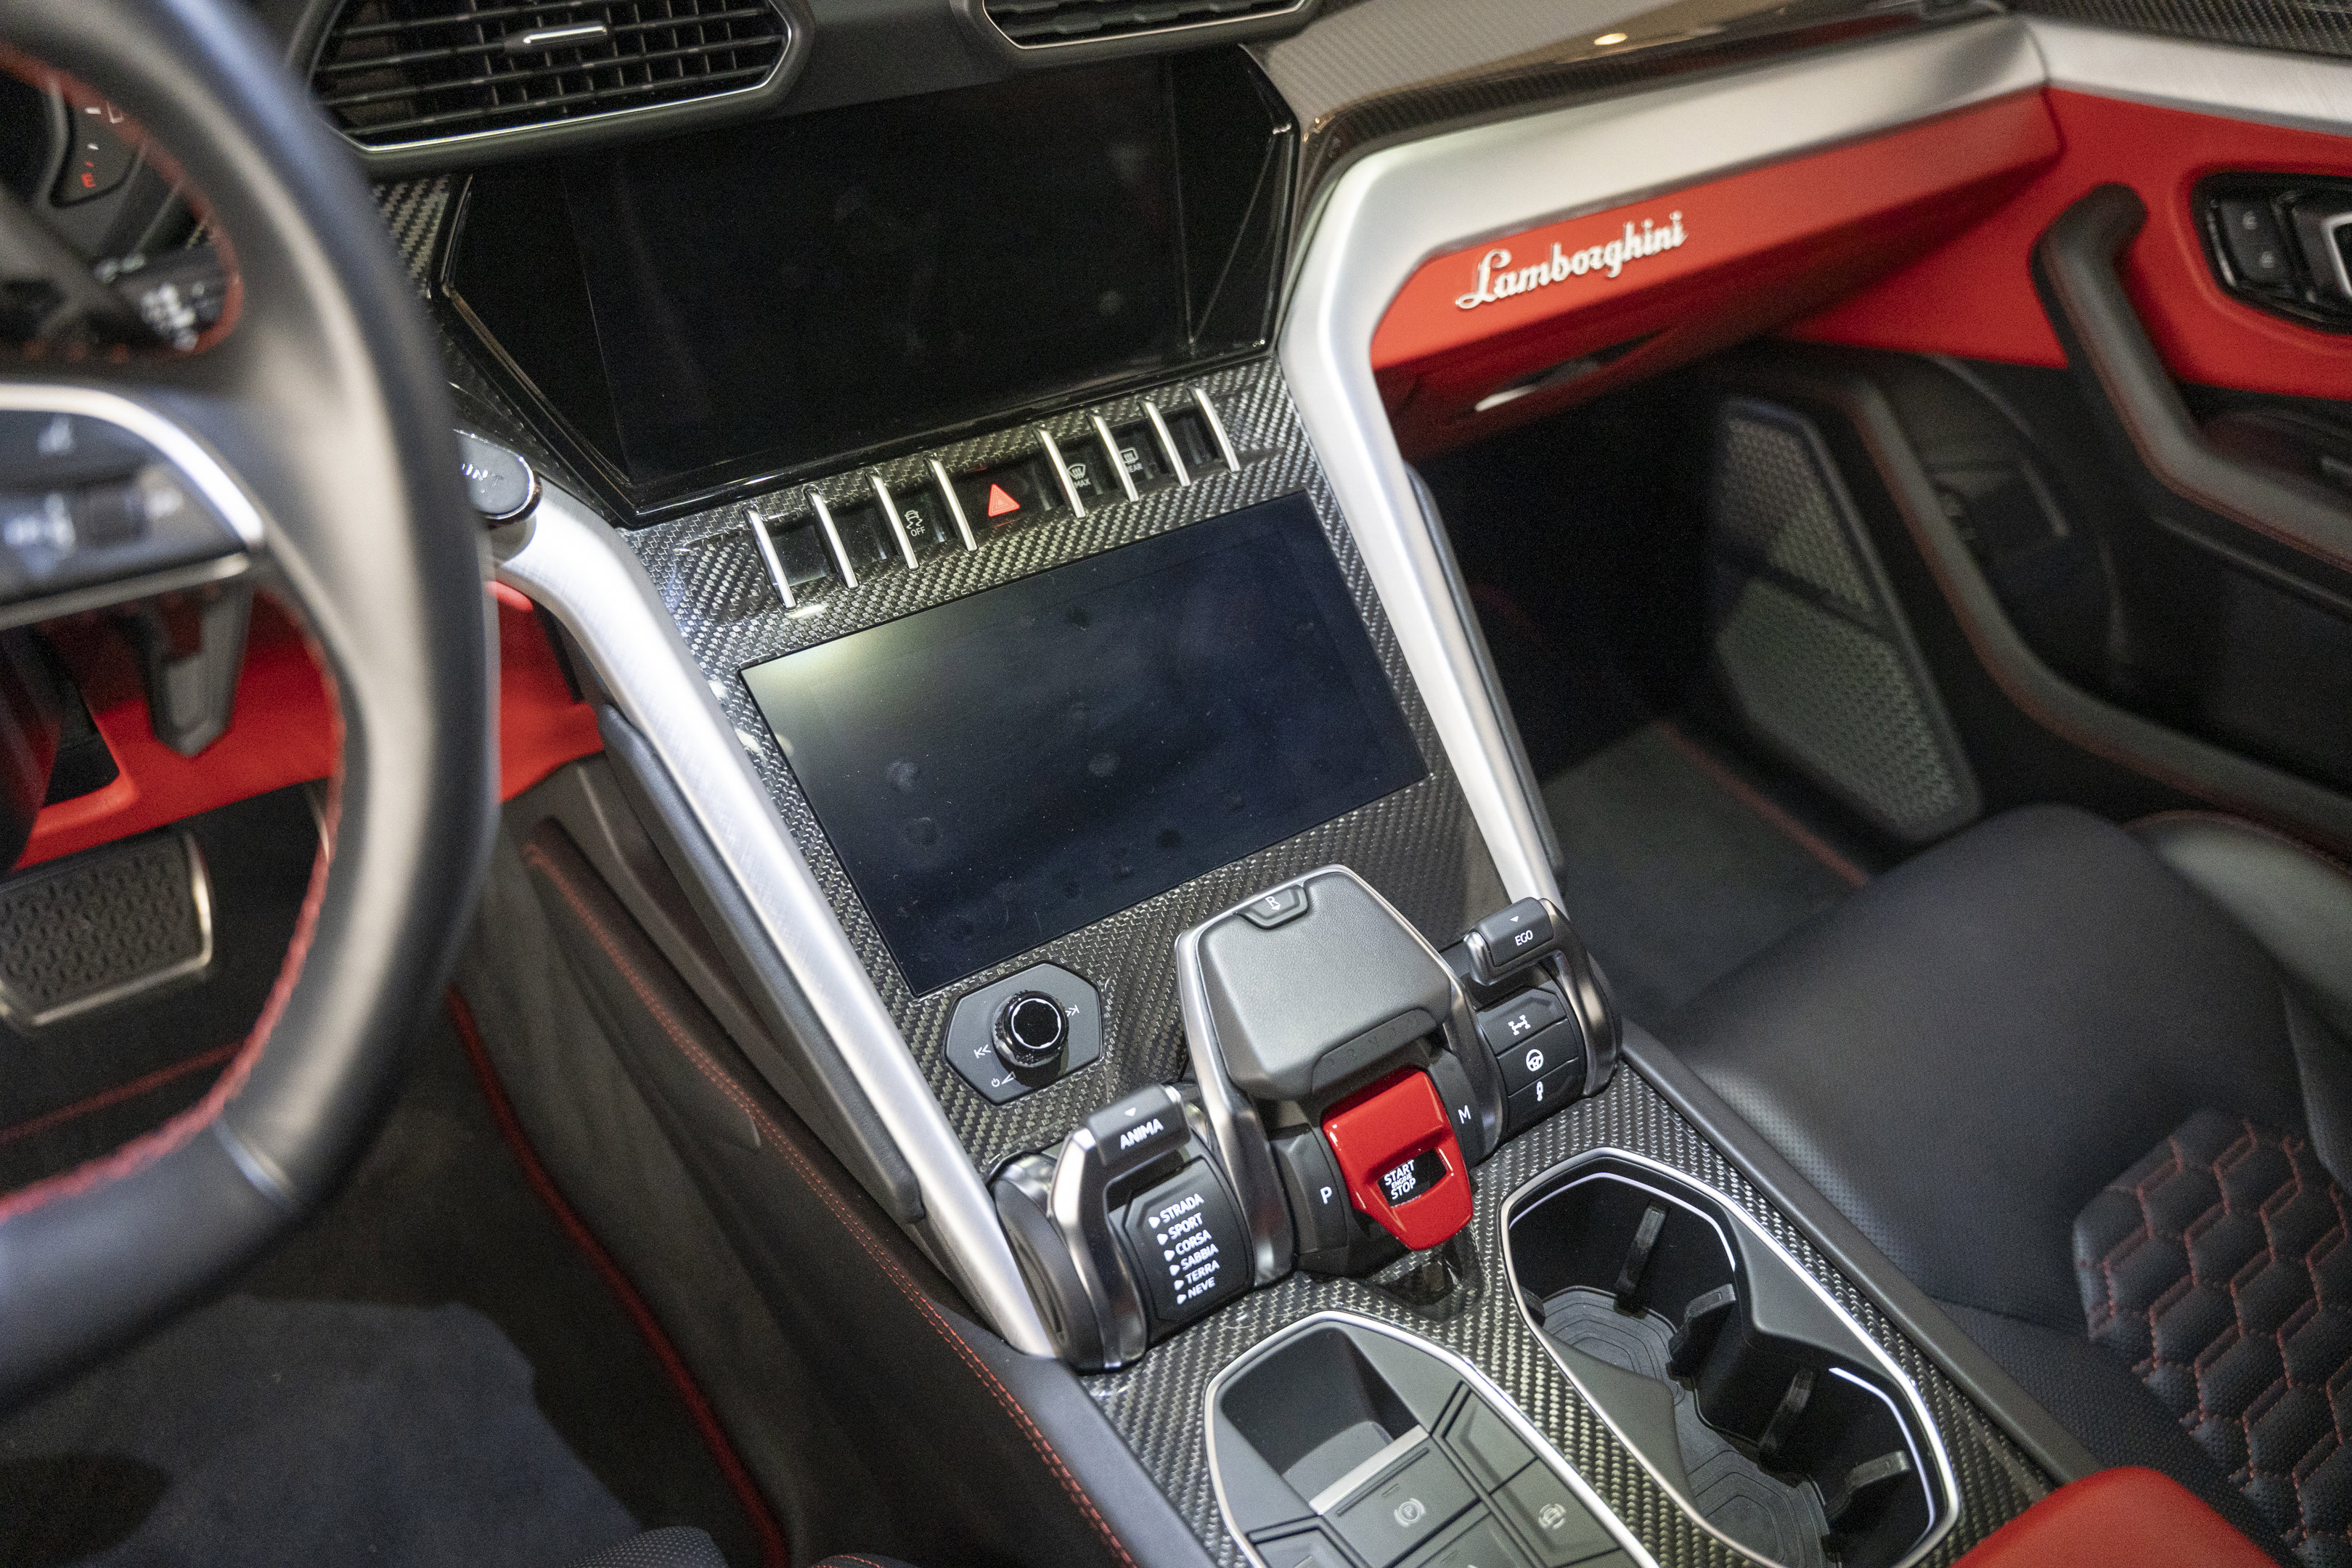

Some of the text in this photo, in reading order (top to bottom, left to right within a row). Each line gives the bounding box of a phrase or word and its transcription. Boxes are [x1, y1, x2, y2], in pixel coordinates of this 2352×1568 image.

[1455, 211, 1689, 309] Lamborghini
[1126, 462, 1143, 473] EAR
[910, 526, 926, 536] OFF
[1515, 930, 1534, 947] EGO
[1458, 1105, 1471, 1124] M
[1120, 1118, 1164, 1150] ANIMA
[1384, 1159, 1414, 1186] START
[1391, 1172, 1413, 1189] ENGINE
[1320, 1185, 1333, 1204] P
[1390, 1177, 1416, 1200] STOP
[1160, 1193, 1204, 1223] STRADA
[1168, 1212, 1204, 1240] SPORT
[1175, 1229, 1212, 1255] CORSA
[1180, 1244, 1220, 1270] SABBIA
[1185, 1259, 1220, 1284] TERRA
[1188, 1276, 1216, 1299] NEVE
